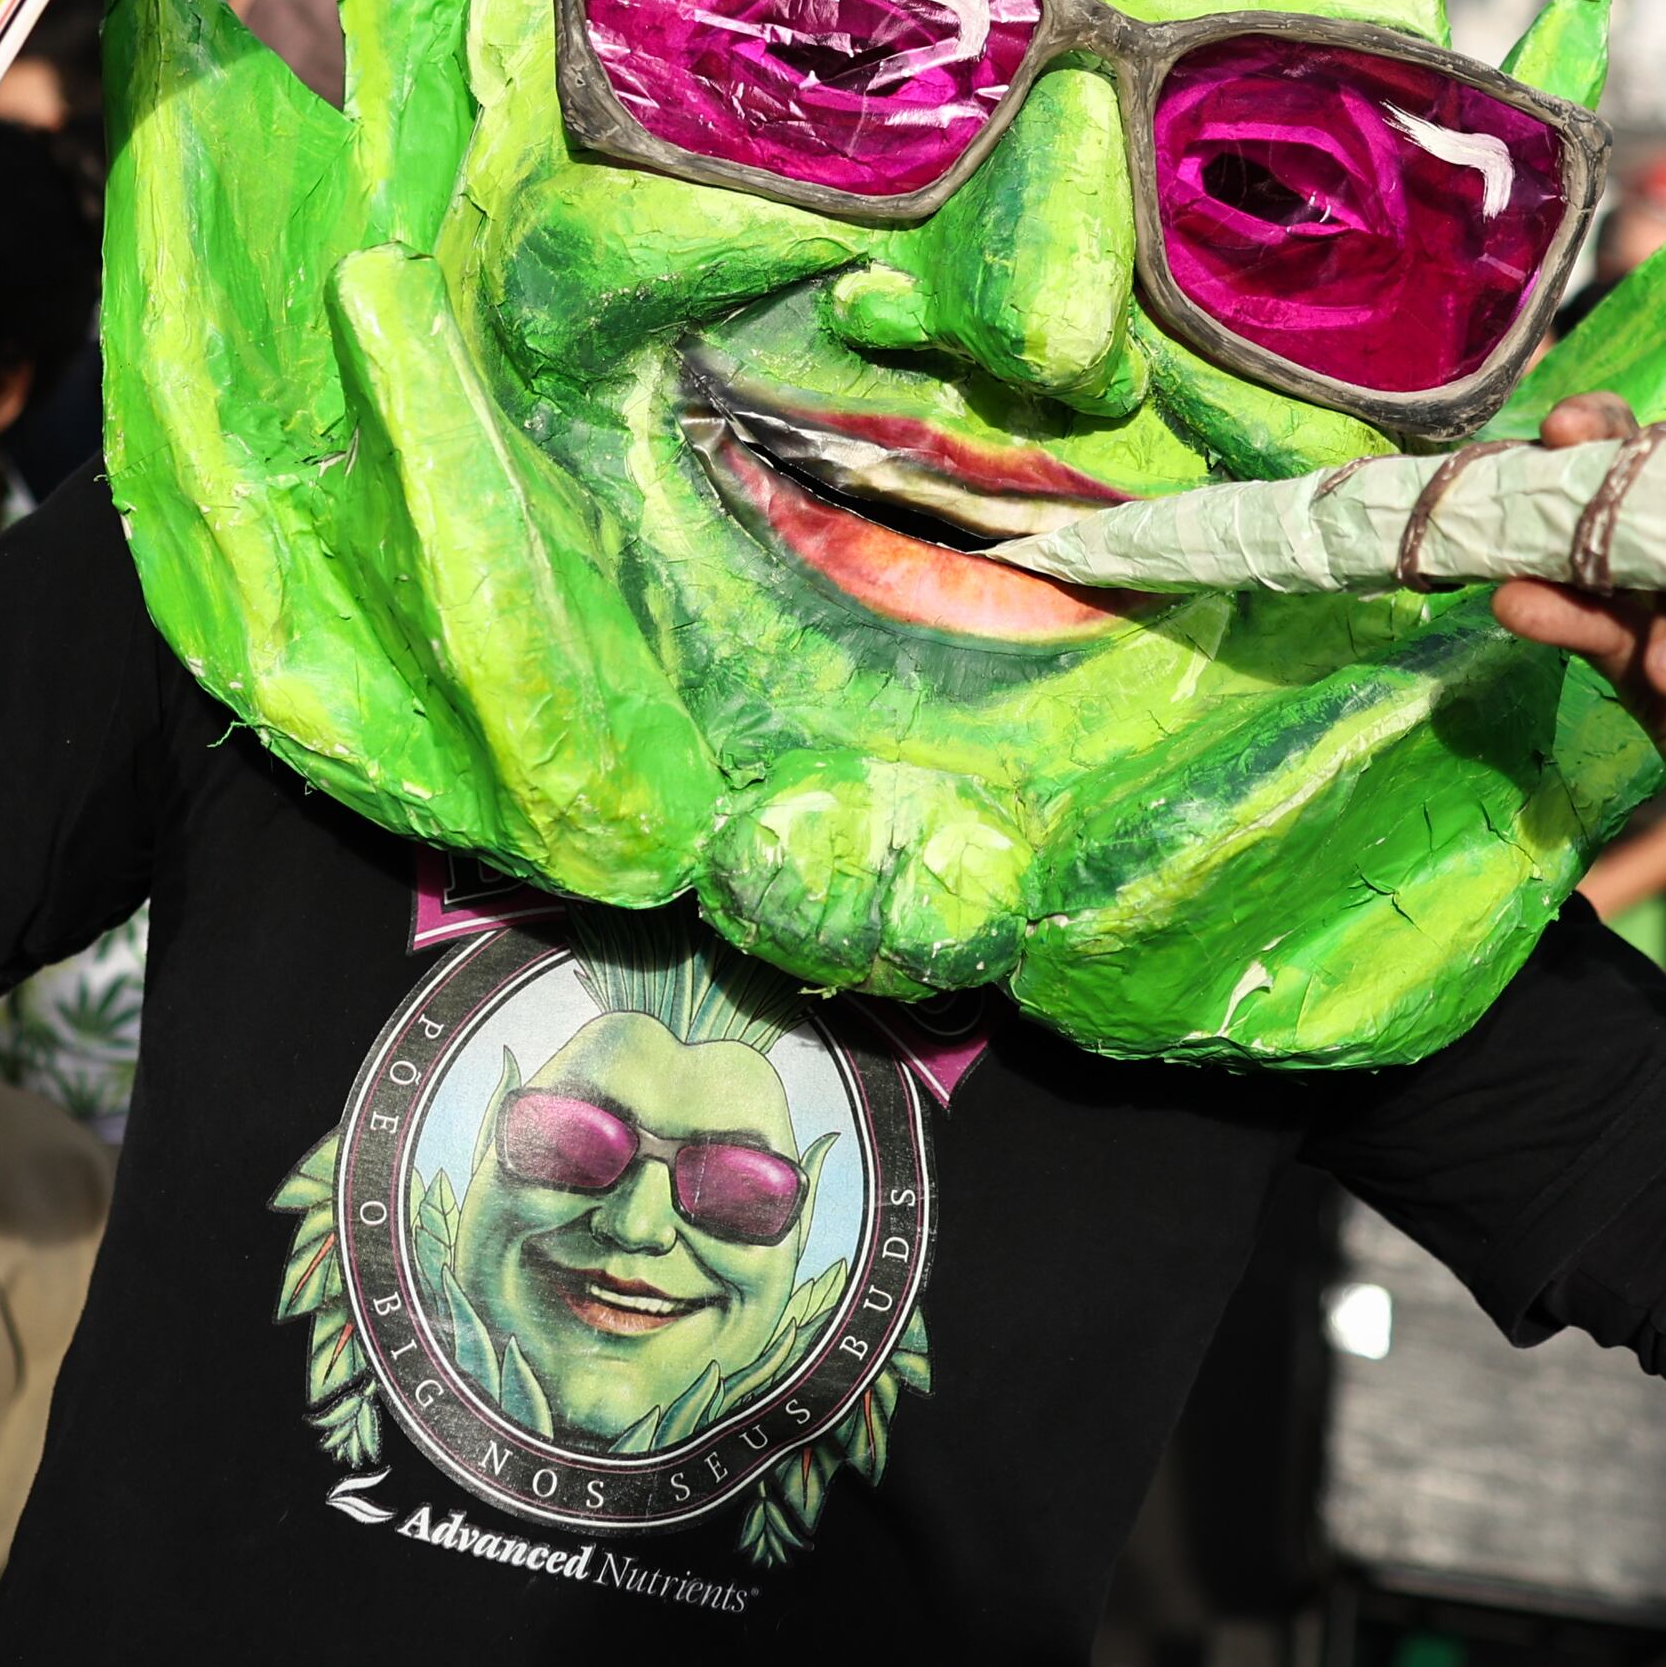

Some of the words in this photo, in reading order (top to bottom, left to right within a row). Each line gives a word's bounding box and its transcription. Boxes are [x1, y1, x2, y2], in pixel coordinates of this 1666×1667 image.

[369, 1013, 445, 1135] PÕE
[359, 1199, 388, 1227] O
[838, 1188, 917, 1362] BUDS
[372, 1290, 445, 1410] BIG
[478, 1439, 605, 1509] NOS
[669, 1398, 812, 1502] SEUS
[397, 1505, 597, 1581] Advanced
